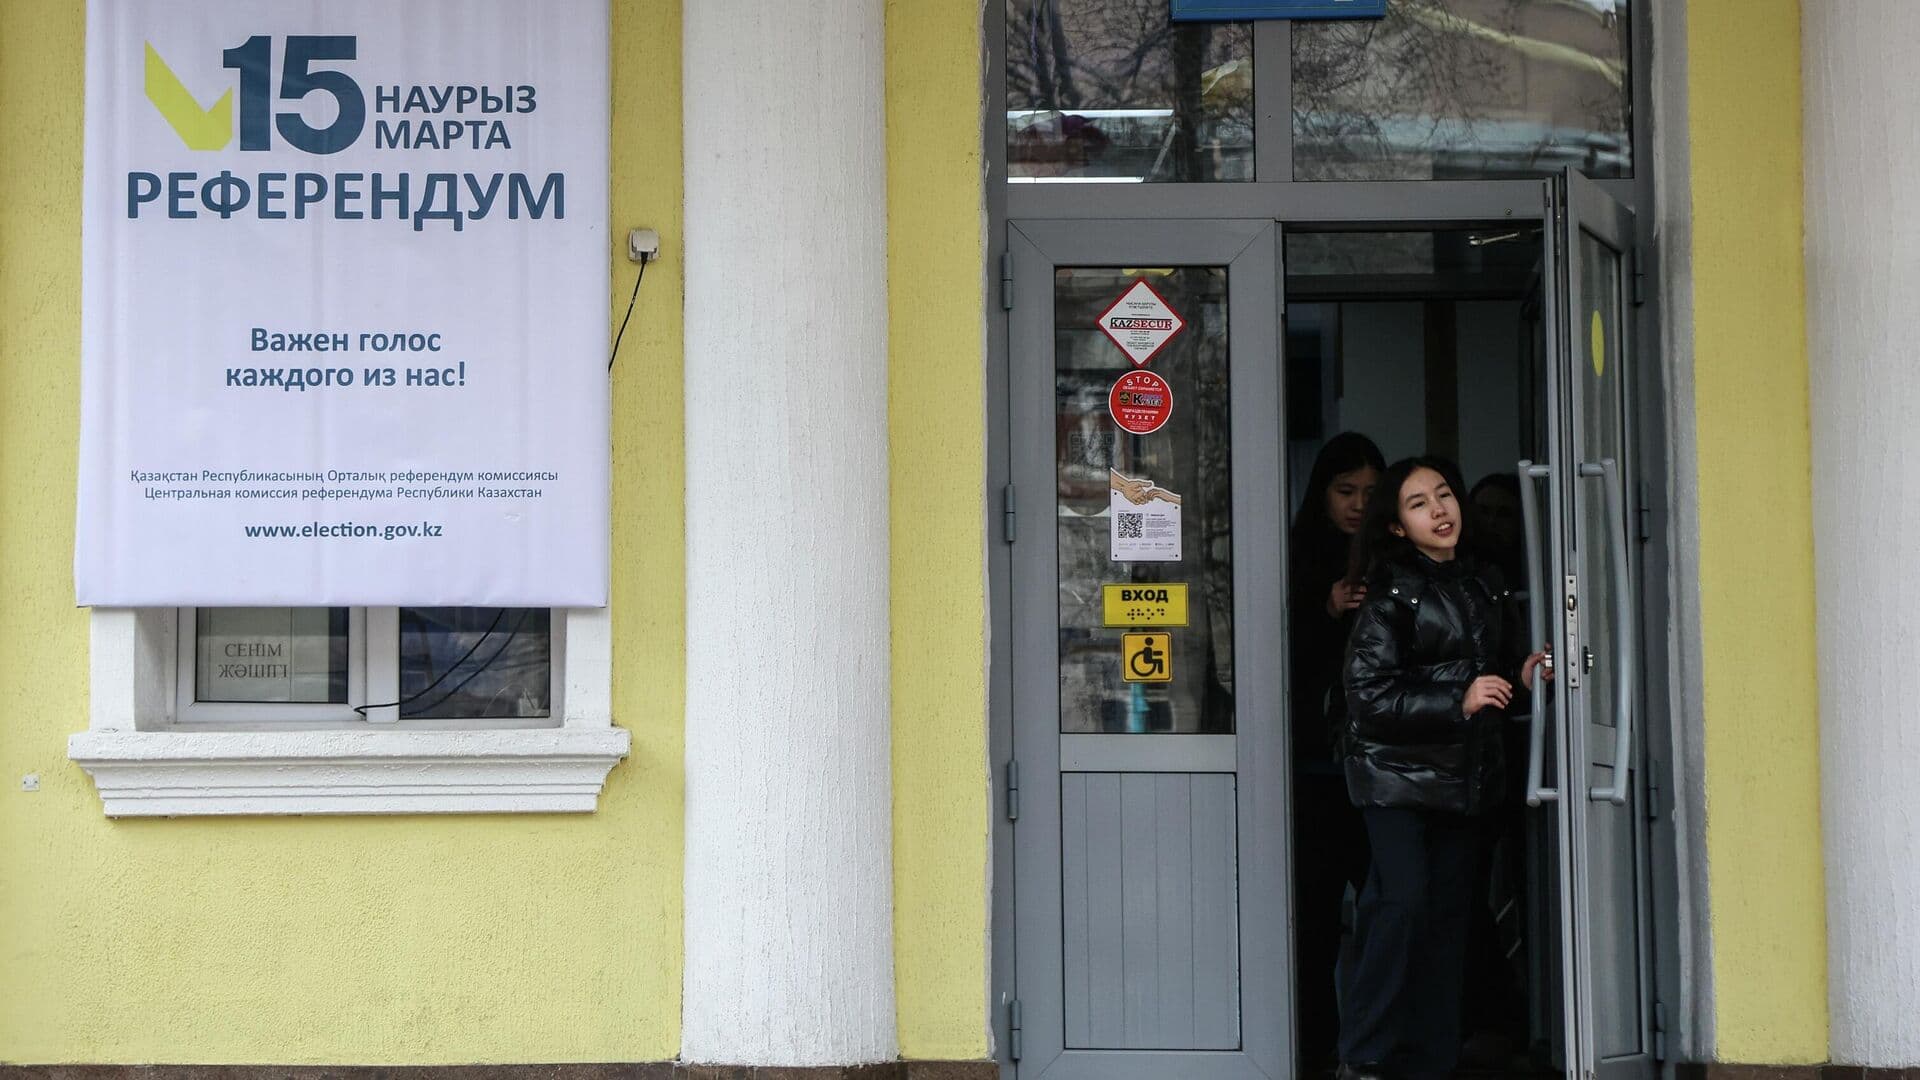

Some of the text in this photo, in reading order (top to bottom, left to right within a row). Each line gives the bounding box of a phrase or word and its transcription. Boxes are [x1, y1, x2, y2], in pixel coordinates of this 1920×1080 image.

[223, 36, 365, 154] 15
[376, 86, 537, 114] НАУРЫЗ
[376, 120, 512, 150] МАРТА
[127, 171, 565, 232] РЕФЕРЕНДУМ
[1110, 318, 1172, 331] KAZSECUR
[251, 328, 441, 352] Важен голос
[226, 362, 465, 392] каждого из нас!
[1126, 376, 1159, 387] STOP
[130, 469, 559, 484] Қазақстан Республикасының Орталық референдум комиссиясы
[144, 486, 542, 500] Центральная комиссия референдума Республики Казахстан
[245, 521, 443, 541] www.election.gov.kz
[1121, 589, 1169, 603] ВХОД
[224, 643, 282, 657] СЕНІМ
